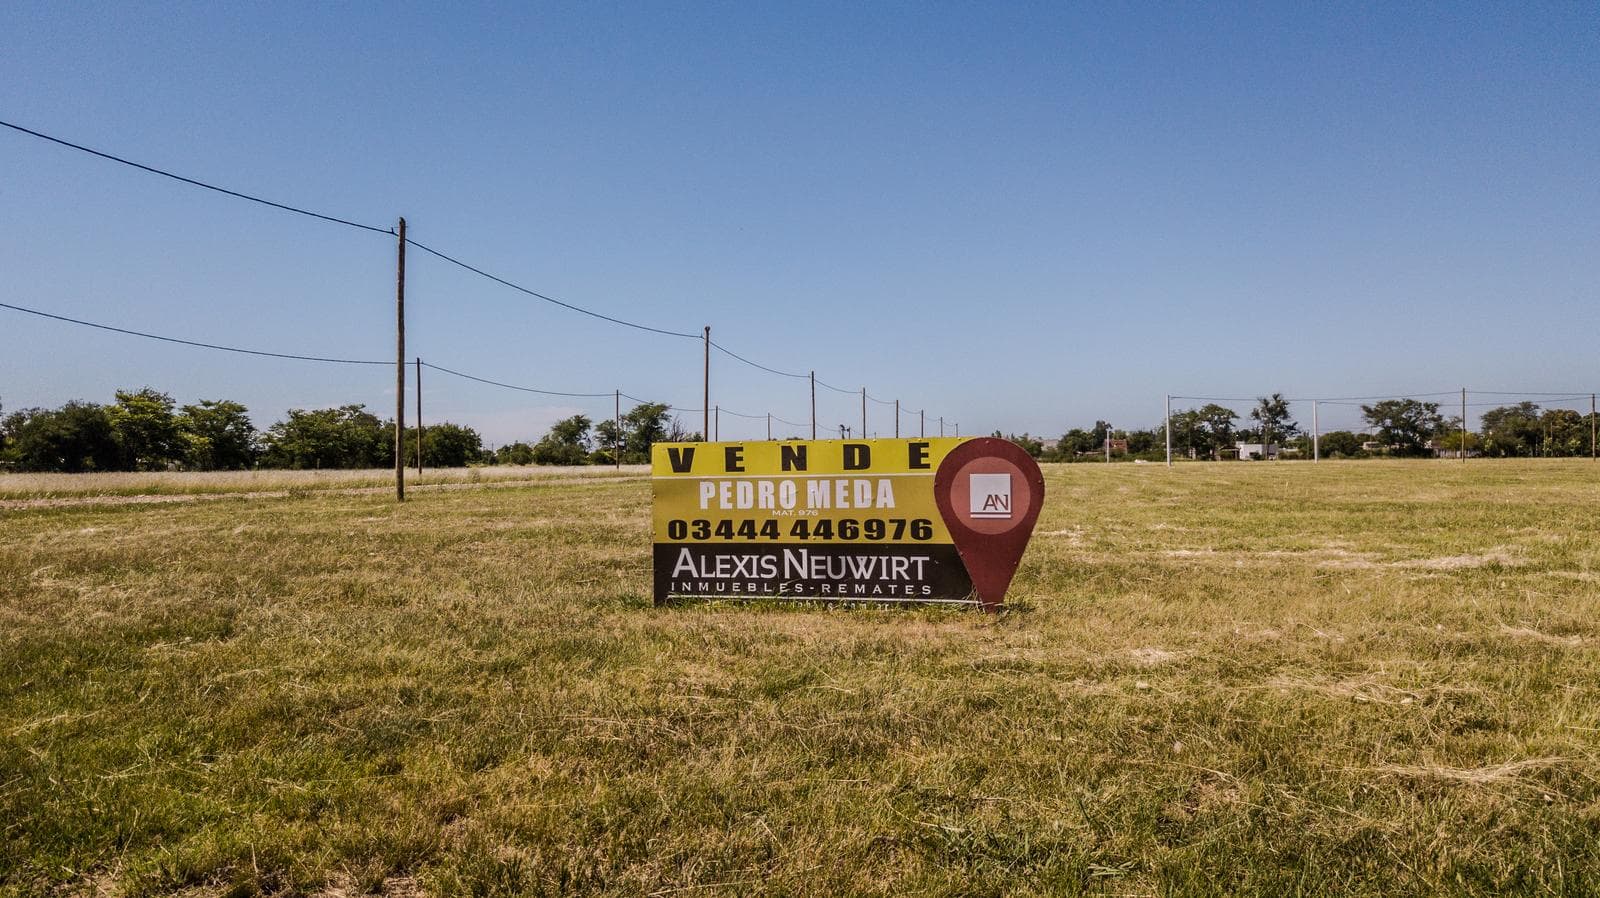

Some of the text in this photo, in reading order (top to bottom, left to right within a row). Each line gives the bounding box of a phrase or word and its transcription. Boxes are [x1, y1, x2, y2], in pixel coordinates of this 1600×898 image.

[667, 442, 931, 473] VENDE
[699, 479, 896, 510] PEDRO MEDA
[982, 494, 1009, 511] AN
[668, 519, 933, 540] 03444 446976
[671, 548, 930, 580] ALEXIS NEUWIRT
